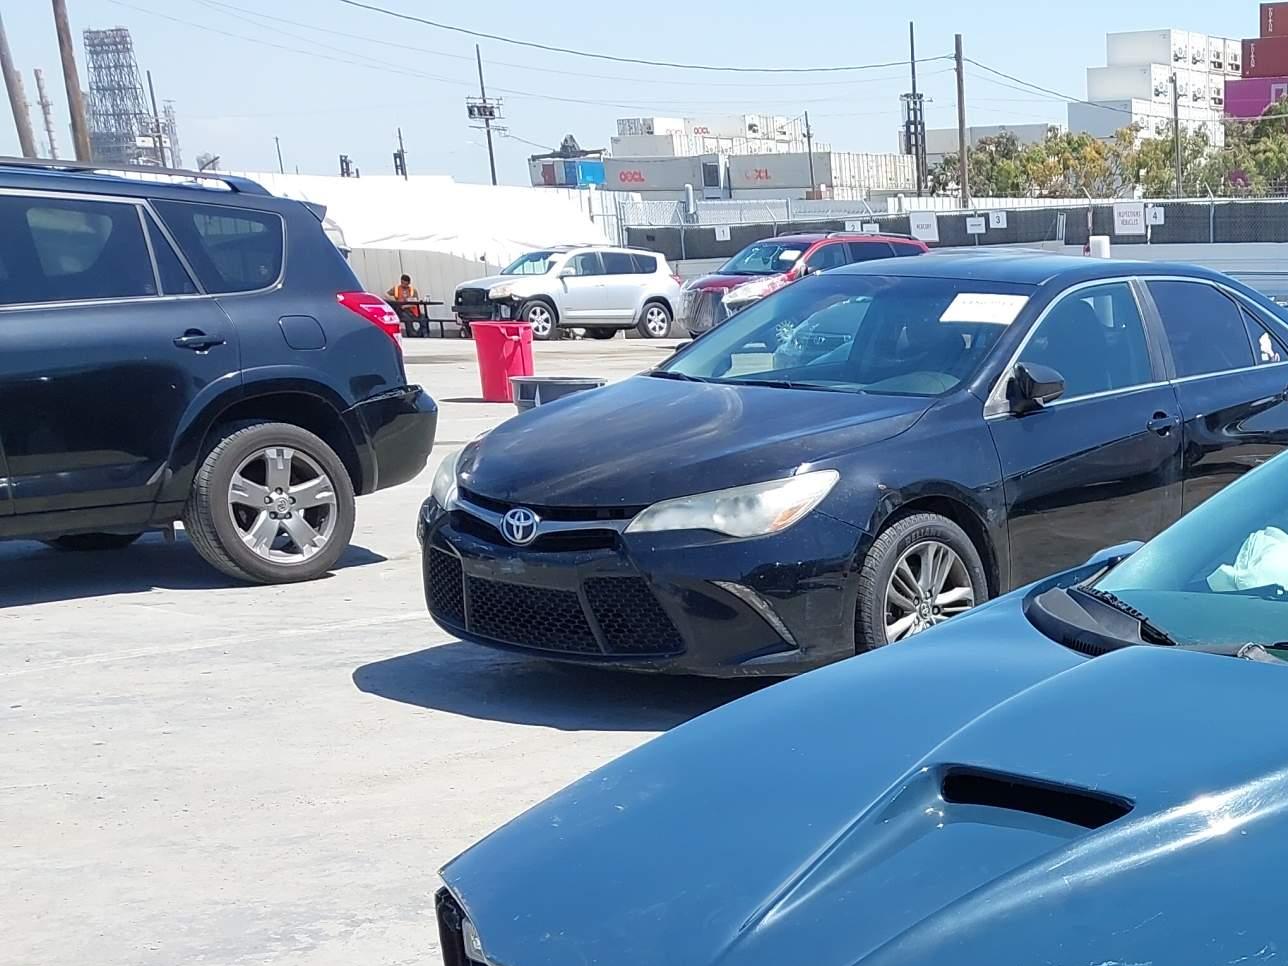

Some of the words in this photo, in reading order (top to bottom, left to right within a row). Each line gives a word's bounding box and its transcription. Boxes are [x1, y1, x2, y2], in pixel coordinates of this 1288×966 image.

[693, 126, 711, 135] OOCL
[619, 170, 646, 183] OOCL
[744, 167, 772, 181] OCL
[995, 215, 1001, 225] 3
[1152, 211, 1158, 221] 4
[850, 223, 857, 232] 2
[721, 229, 726, 238] 1
